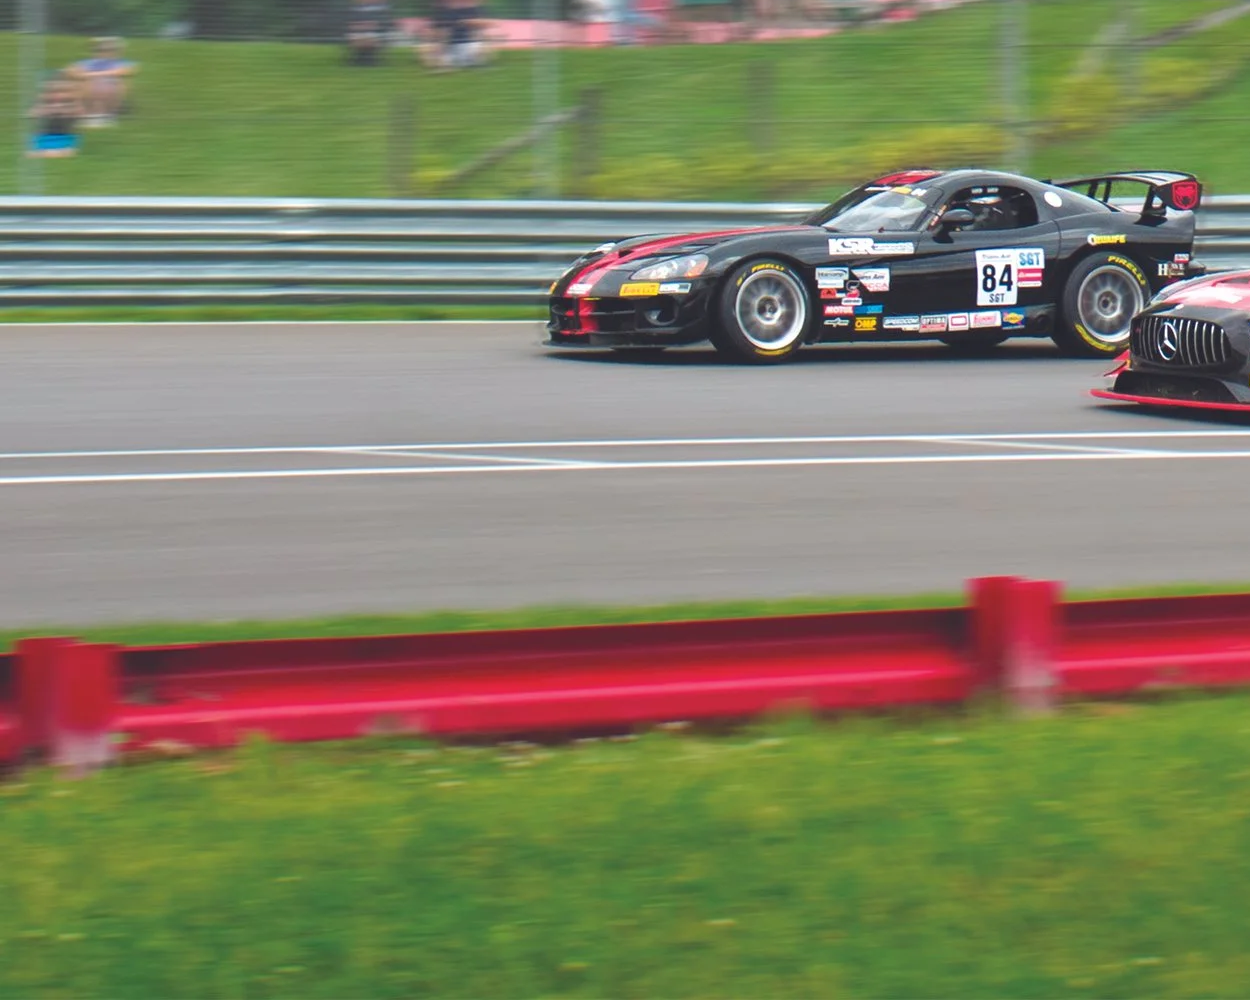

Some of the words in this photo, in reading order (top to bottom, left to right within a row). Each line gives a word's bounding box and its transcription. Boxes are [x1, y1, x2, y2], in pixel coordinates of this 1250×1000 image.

[1019, 252, 1041, 266] SGT
[752, 263, 785, 273] PIRELLI
[1107, 255, 1147, 286] PIRELLI
[982, 263, 1013, 293] 84
[988, 293, 1005, 304] SGT
[855, 318, 877, 328] OMP
